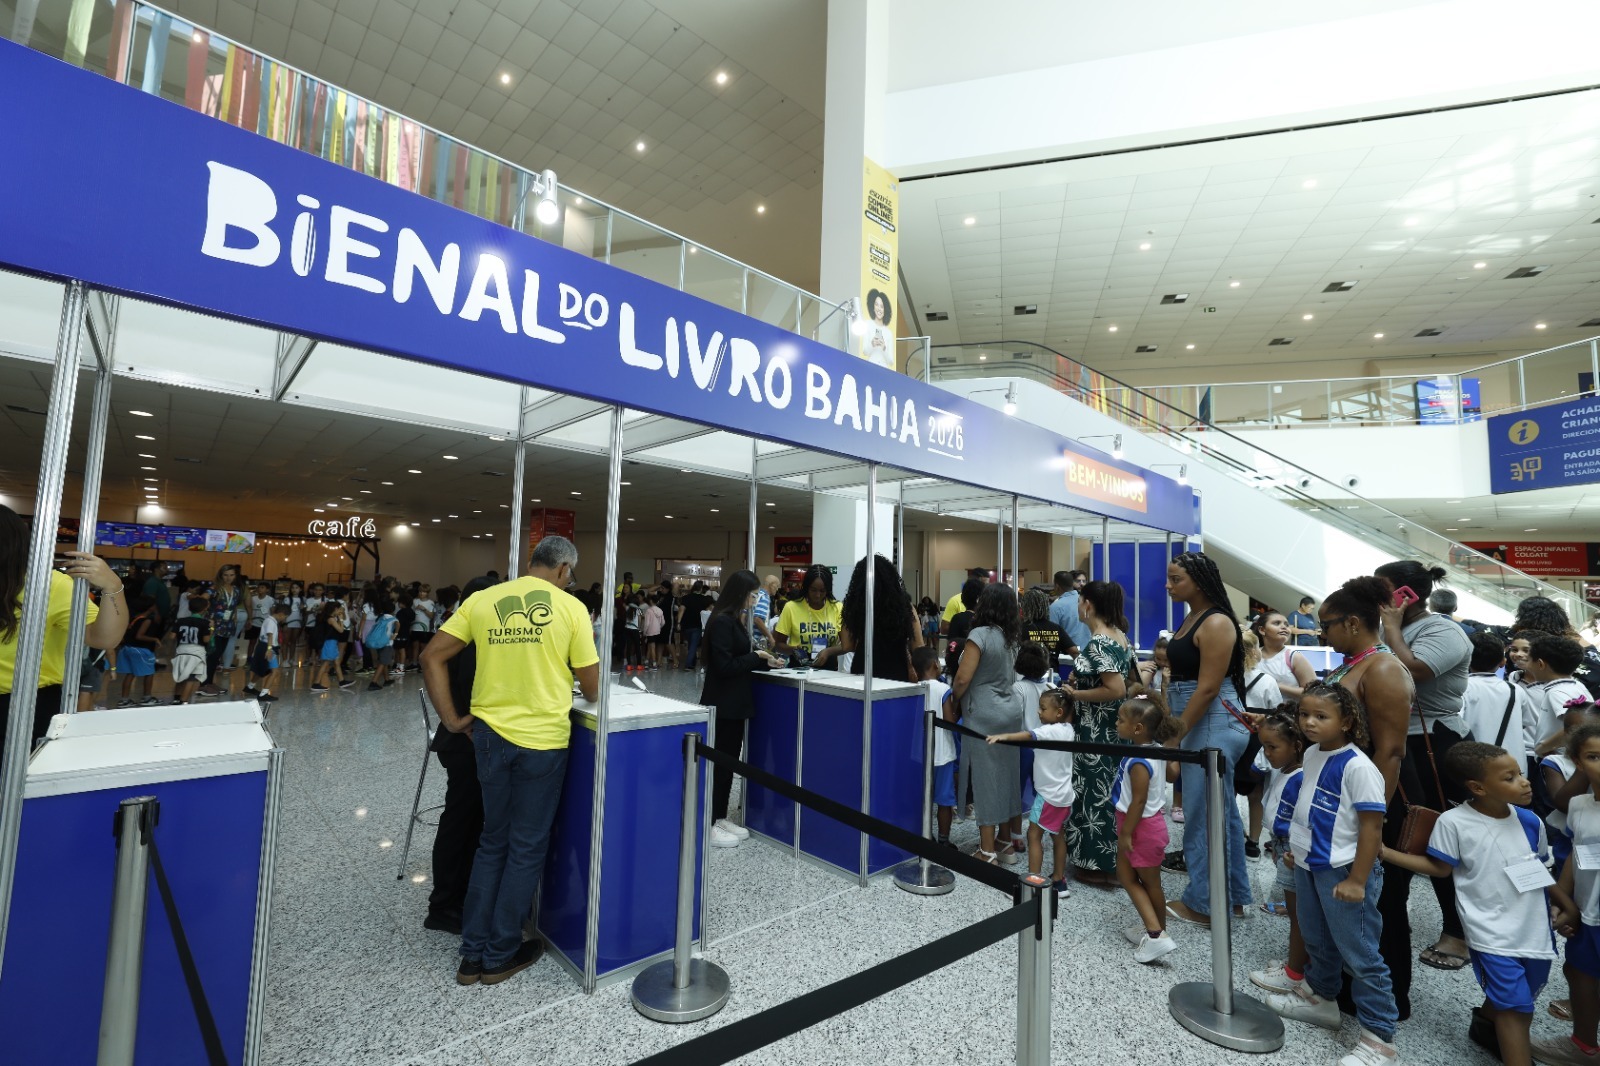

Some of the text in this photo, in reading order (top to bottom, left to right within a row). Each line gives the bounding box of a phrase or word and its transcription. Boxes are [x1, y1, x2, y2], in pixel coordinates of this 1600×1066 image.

[558, 282, 609, 330] DO
[619, 302, 793, 410] LIVRO
[927, 416, 965, 452] 2026
[1562, 416, 1600, 429] CRIAN
[1563, 448, 1600, 461] PAGUE
[1564, 460, 1600, 470] ENTRADA
[1068, 462, 1144, 504] BEM-VINDOS
[308, 516, 376, 538] café
[1514, 545, 1543, 553] ESPAÇO
[177, 626, 199, 645] 30
[487, 627, 543, 636] TURISMO
[488, 637, 543, 645] EDUCACIONAL
